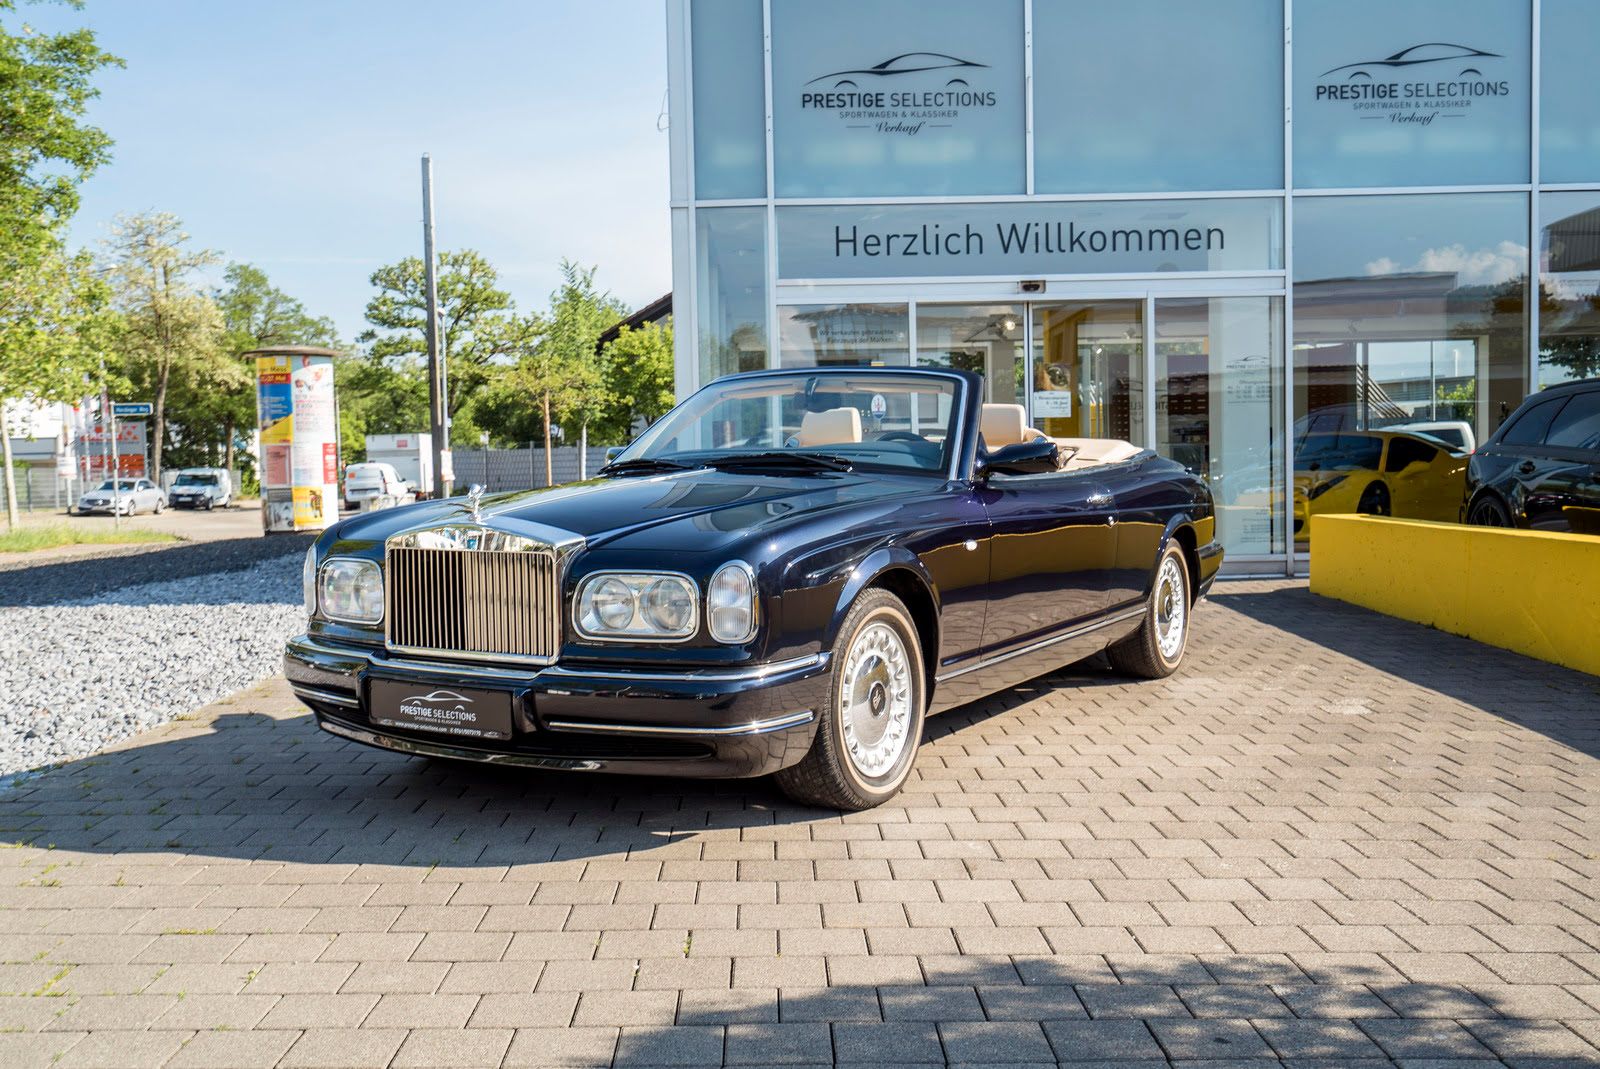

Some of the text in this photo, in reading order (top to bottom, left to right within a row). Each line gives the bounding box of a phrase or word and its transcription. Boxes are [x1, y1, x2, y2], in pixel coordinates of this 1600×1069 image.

[1316, 81, 1509, 100] PRESTIGE SELECTIONS
[802, 92, 996, 108] PRESTIGE SELECTIONS
[1353, 102, 1411, 110] SPORTWAGEN
[1424, 100, 1471, 108] KLASSIKER
[839, 111, 898, 119] SPORTWAGEN
[911, 110, 958, 118] KLASSIKER
[1388, 111, 1439, 125] Verkauf
[875, 121, 926, 136] Verkauf
[835, 221, 1225, 257] Herzlich Willkommen
[400, 705, 477, 722] PRESTIGE SELECTIONS
